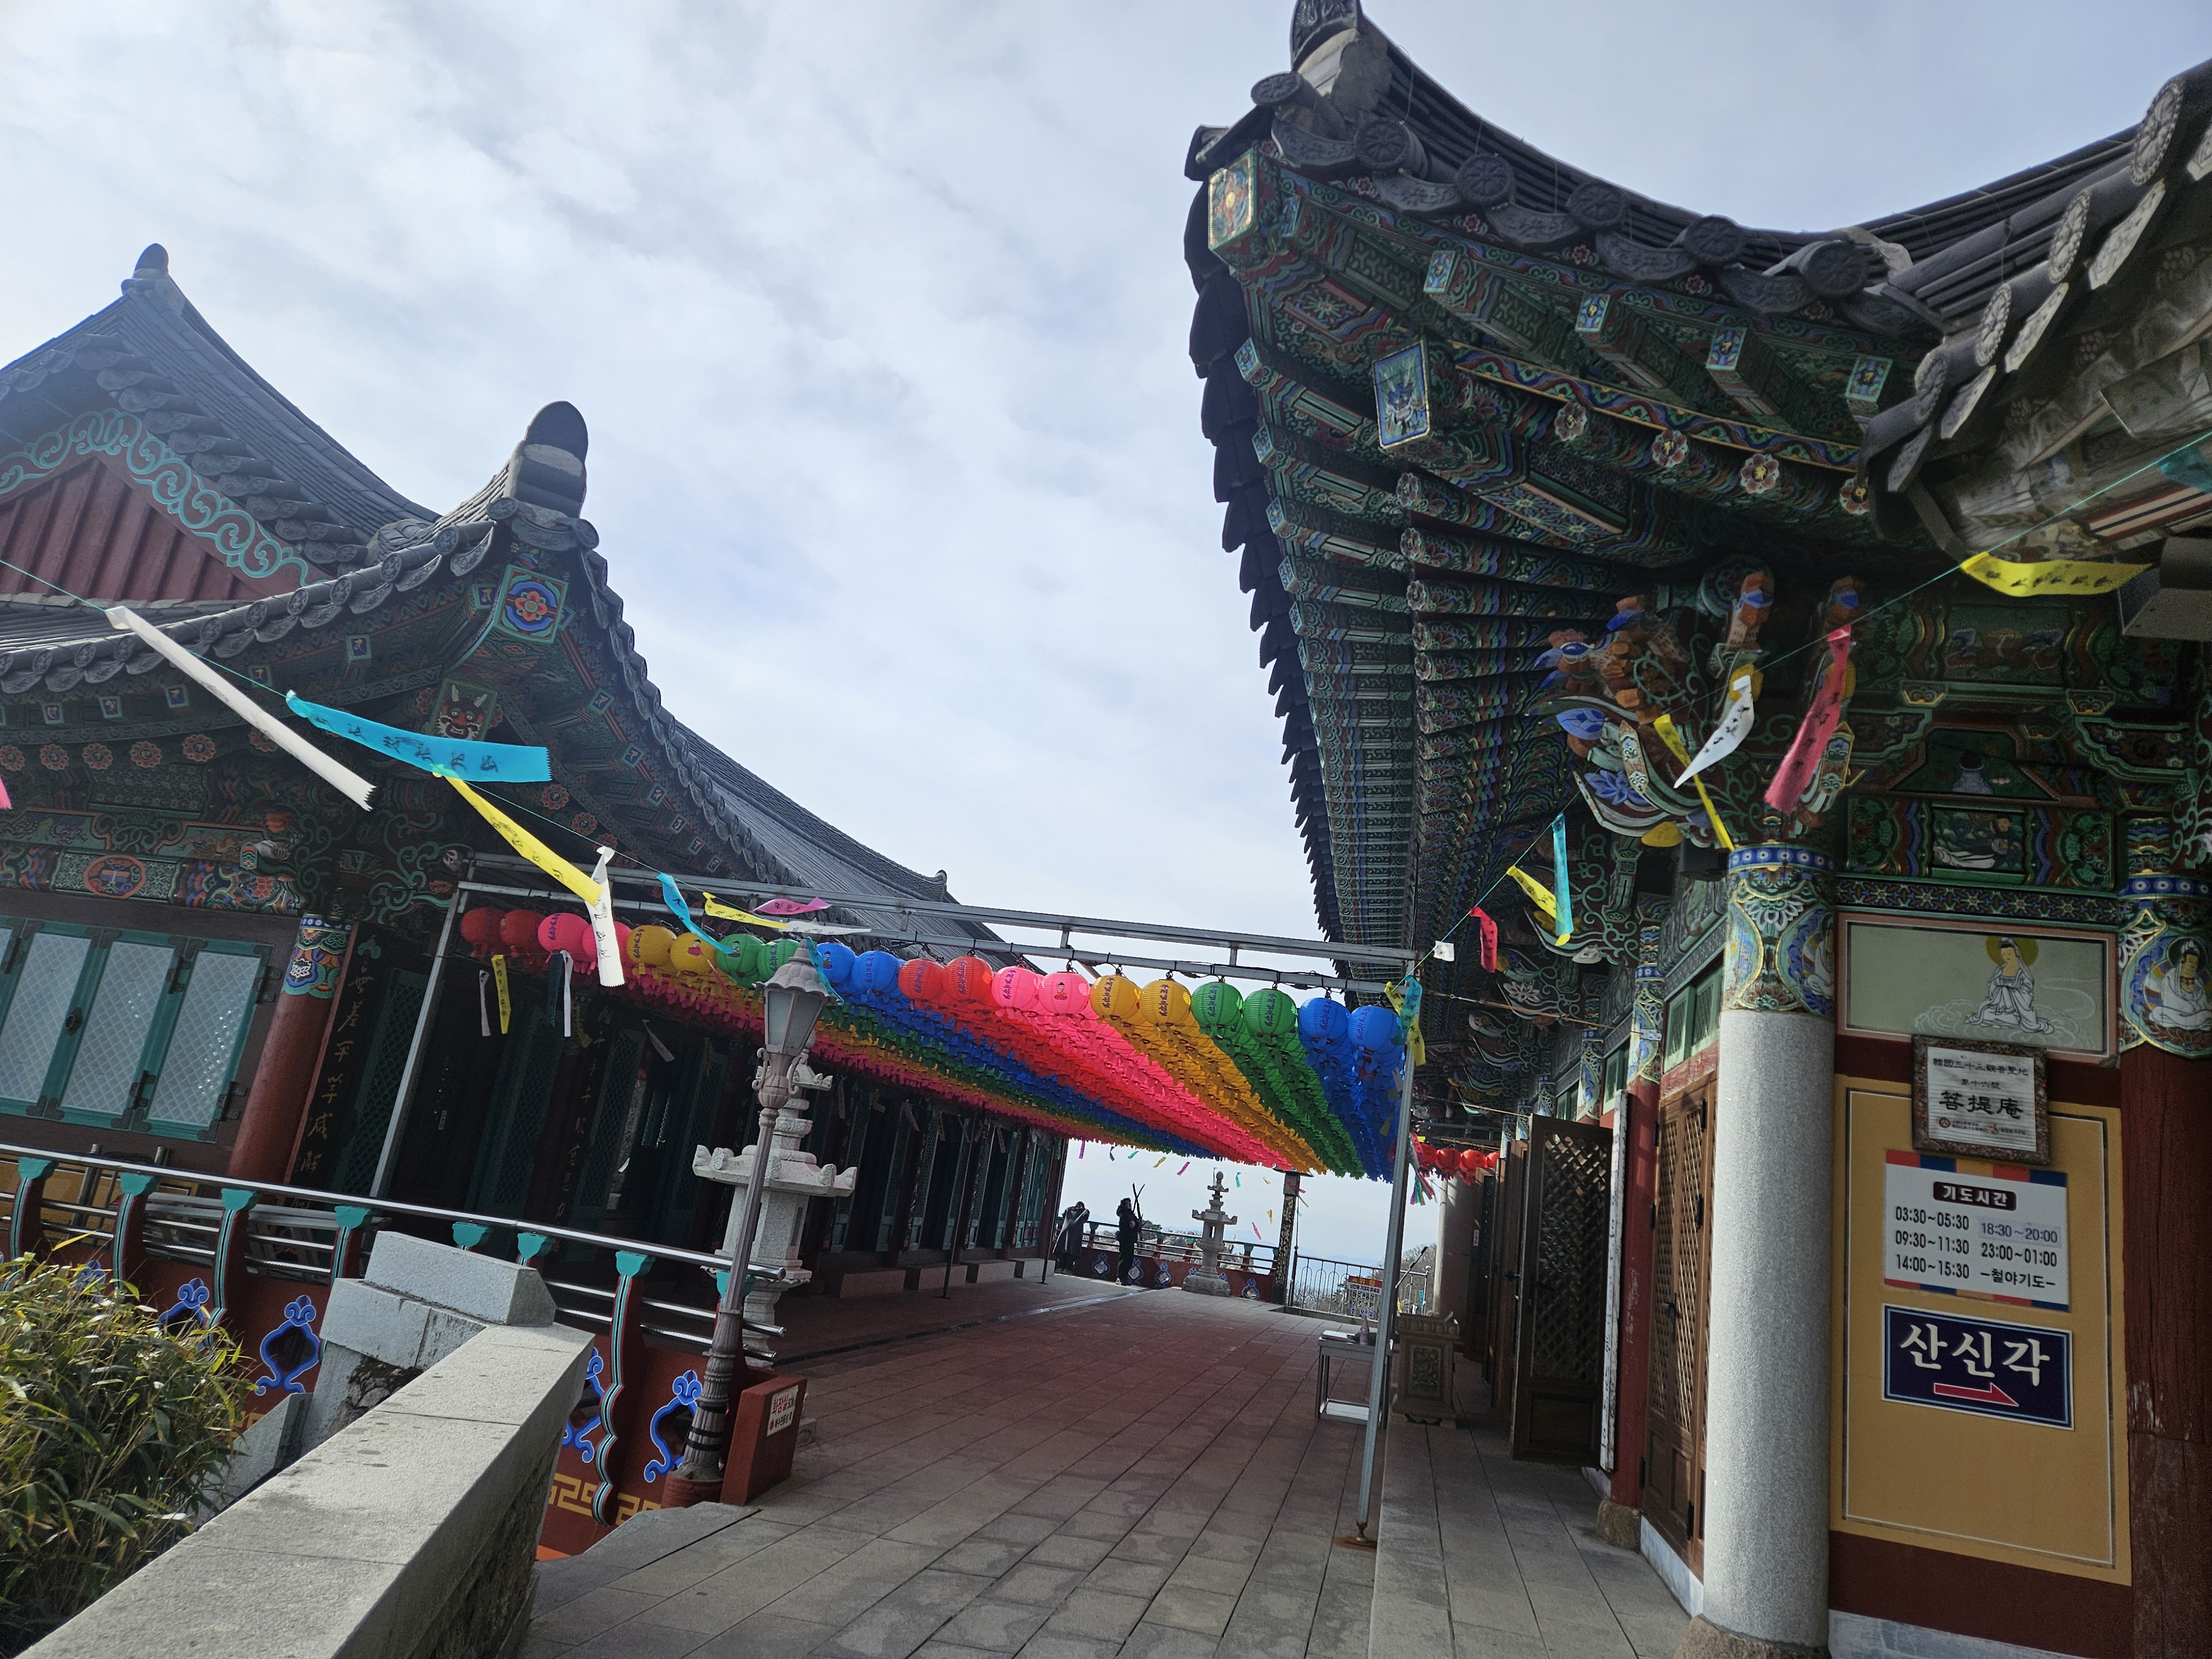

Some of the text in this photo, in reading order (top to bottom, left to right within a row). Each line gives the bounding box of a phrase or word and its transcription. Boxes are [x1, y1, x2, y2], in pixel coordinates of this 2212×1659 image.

[1158, 984, 1170, 1017] 부처님오신날
[1939, 1091, 2024, 1120] 菩提庵
[1943, 1185, 2007, 1207] 기도시간
[1896, 1206, 1969, 1230] 03:30~05:30
[1896, 1230, 1969, 1255] 09:30~11:30
[1981, 1242, 2057, 1267] 23:00~01:00
[1896, 1254, 1970, 1279] 14:00~15:30
[1900, 1323, 2051, 1386] 산신각
